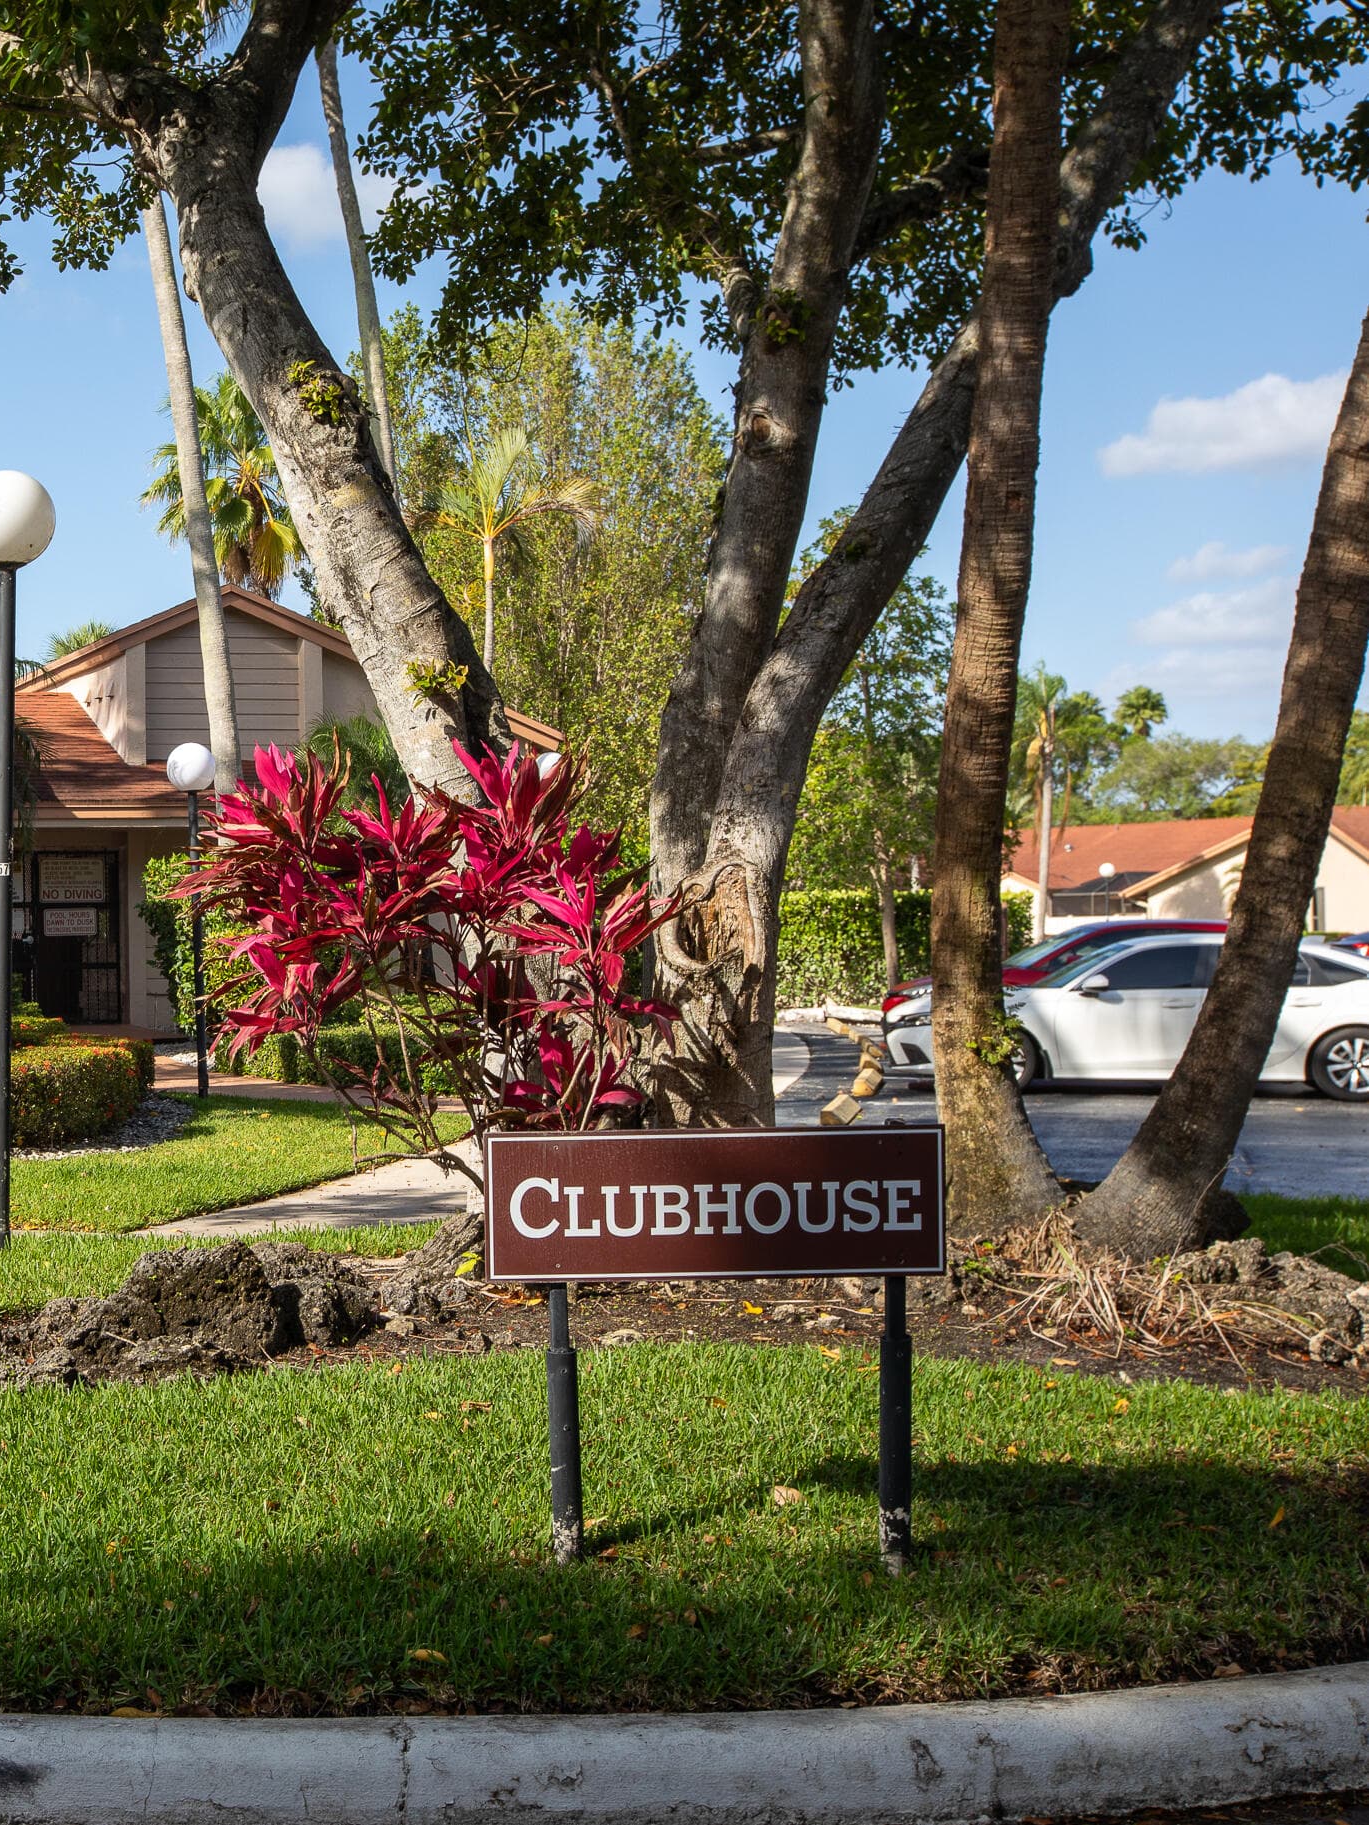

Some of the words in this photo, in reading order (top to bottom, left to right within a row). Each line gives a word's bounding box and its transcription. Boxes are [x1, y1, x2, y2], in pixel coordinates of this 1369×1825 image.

[42, 889, 59, 899] NO
[64, 889, 103, 899] DIVING
[50, 911, 66, 919] POOL
[509, 1177, 922, 1239] CLUBHOUSE
